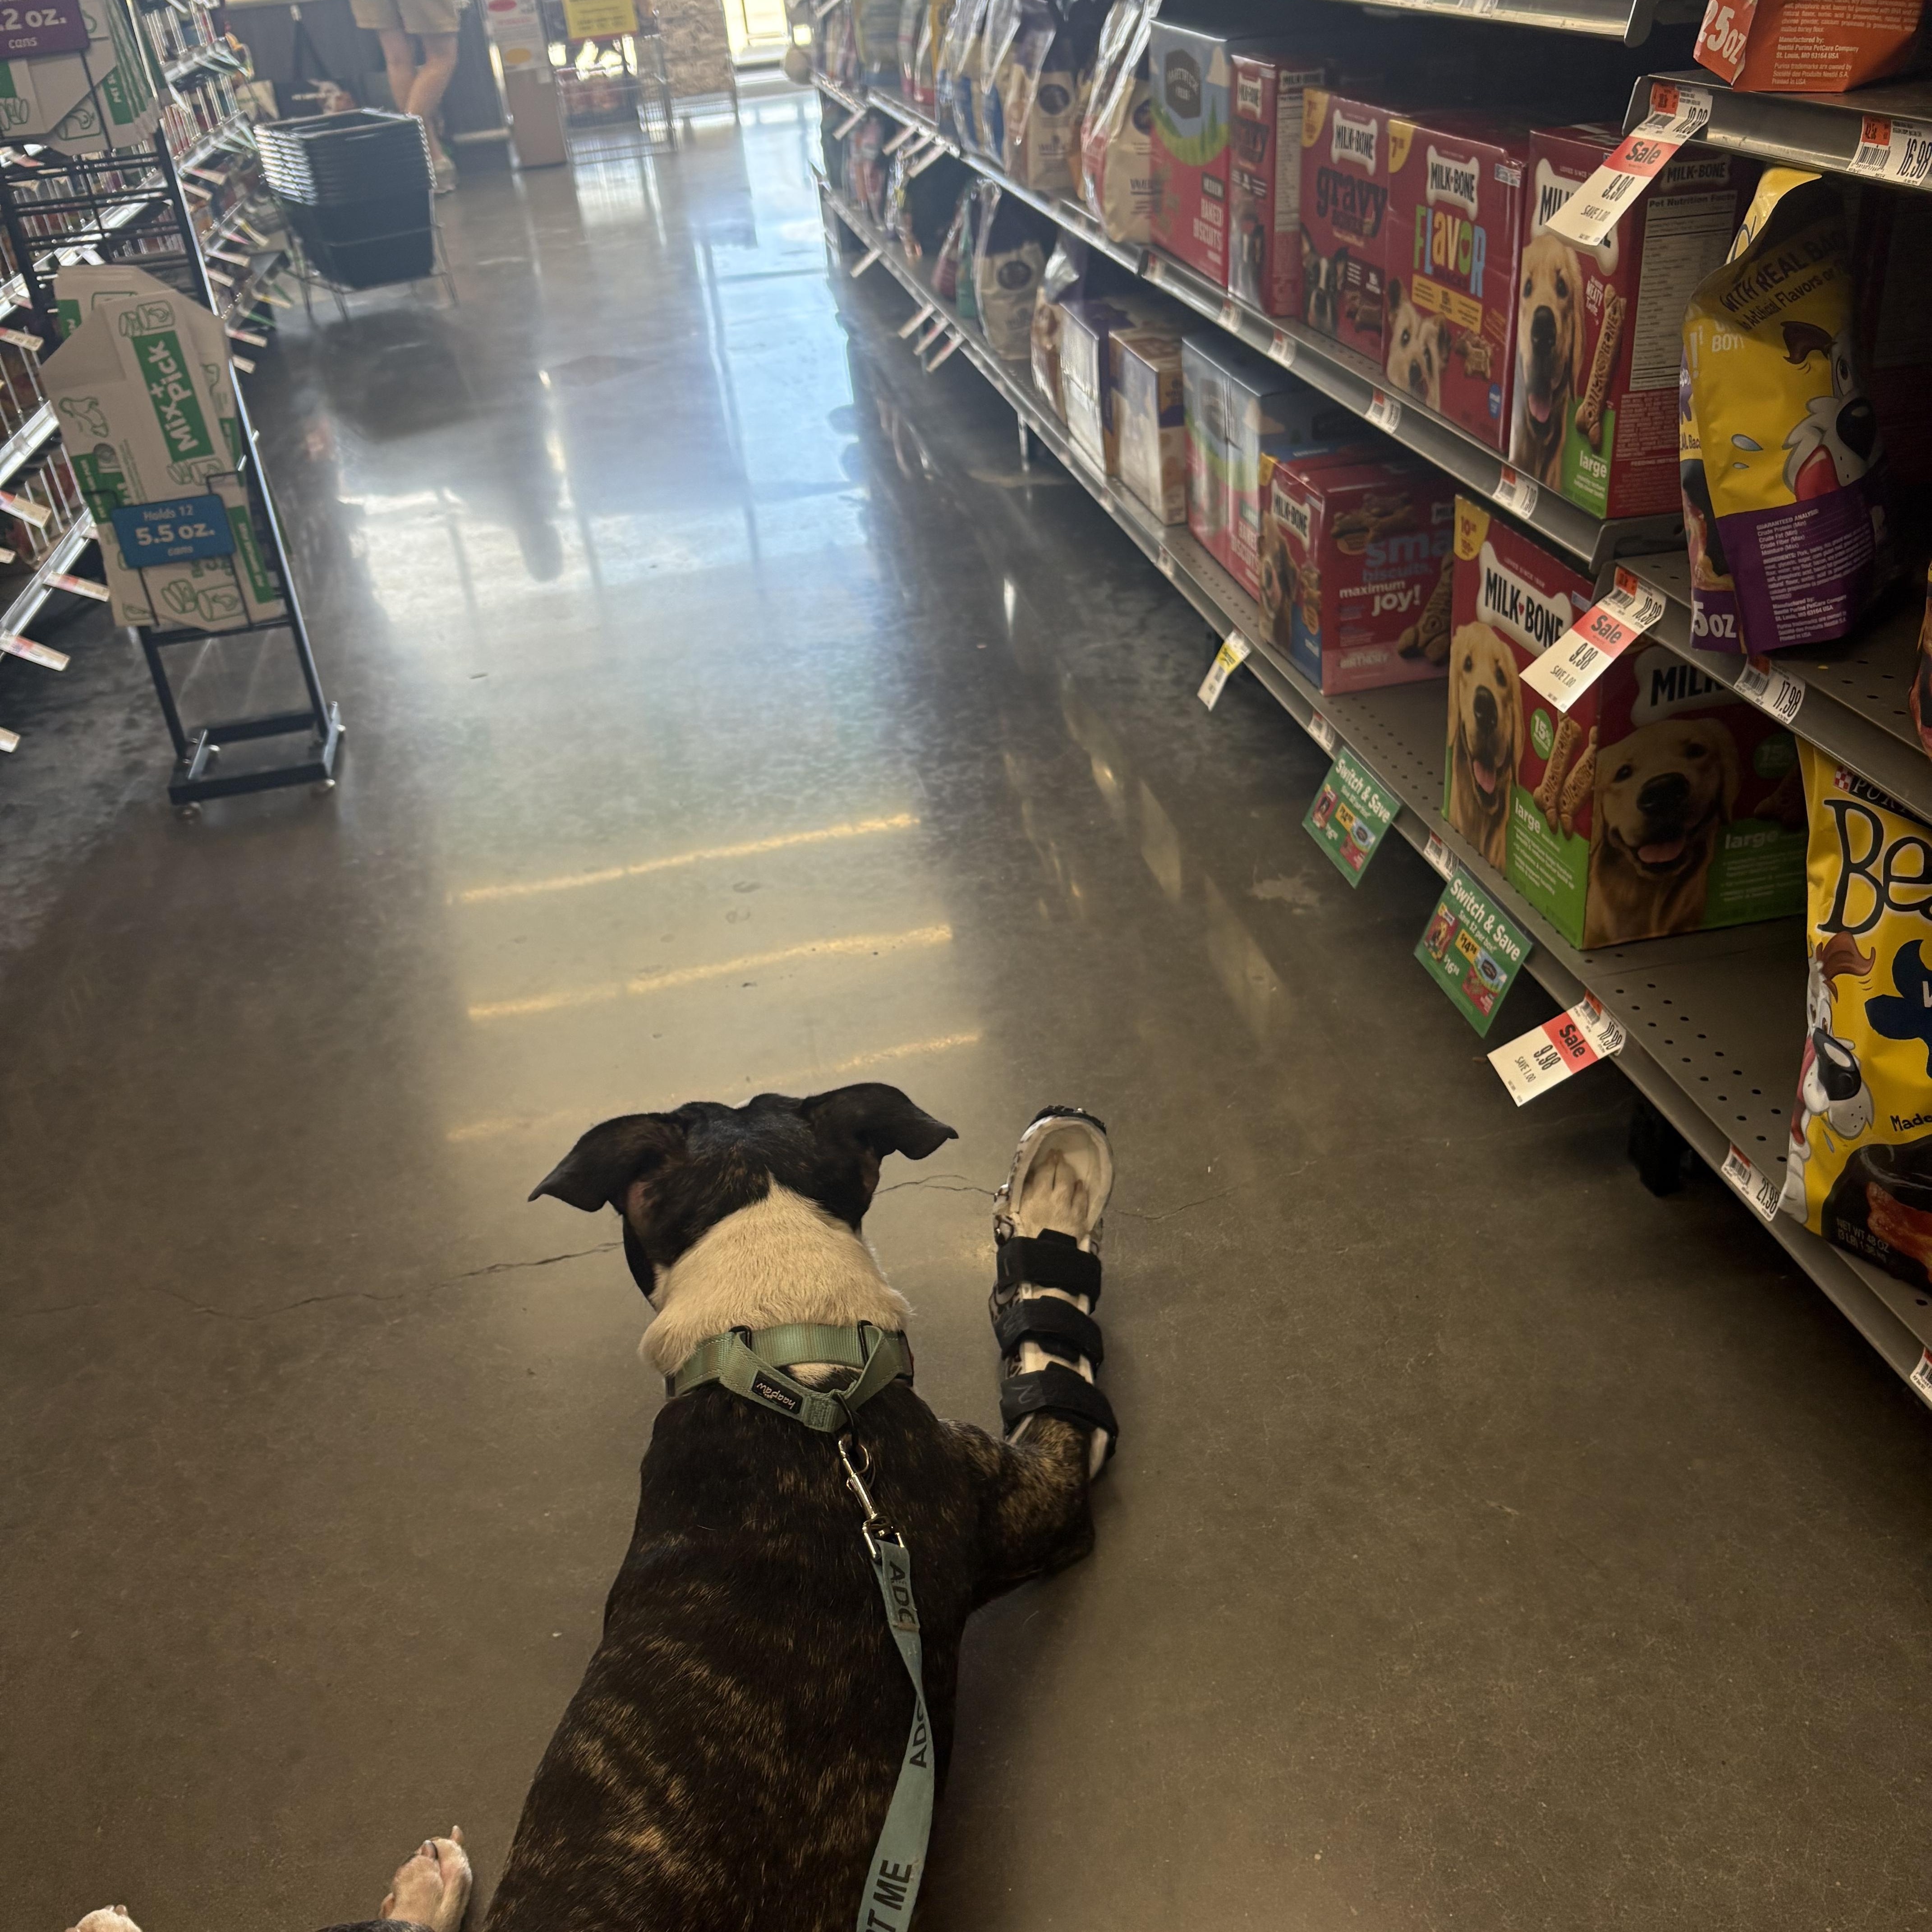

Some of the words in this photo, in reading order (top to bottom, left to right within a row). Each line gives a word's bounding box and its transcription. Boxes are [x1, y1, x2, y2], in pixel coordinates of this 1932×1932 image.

[25, 9, 67, 28] oz.
[9, 37, 37, 48] cans
[1625, 141, 1661, 165] Sale
[1896, 138, 1932, 179] 16.98
[1316, 166, 1388, 237] gravy
[1601, 174, 1635, 202] 9.98
[1720, 277, 1759, 313] WITH
[1755, 252, 1809, 293] REAL
[1775, 276, 1823, 308] Flavors
[158, 400, 199, 452] Mix
[1579, 450, 1607, 478] large
[143, 510, 176, 521] Holds
[179, 505, 194, 516] 12
[135, 524, 175, 546] 5.5
[178, 523, 216, 539] oz.
[167, 546, 194, 556] cans
[1339, 580, 1406, 598] maximum
[1371, 584, 1421, 616] joy!
[1591, 615, 1622, 644] Sale
[1569, 642, 1597, 671] 9.98
[1550, 664, 1566, 682] SAVE
[1773, 680, 1801, 718] 17.98
[1335, 759, 1364, 795] Switch
[1368, 794, 1390, 823] Save
[1515, 797, 1541, 834] large
[1817, 799, 1932, 934] Be
[1450, 878, 1485, 923] Switch
[1483, 914, 1495, 934] &
[1493, 924, 1520, 961] Save
[1559, 1023, 1586, 1058] Sale
[1514, 1056, 1530, 1072] SAVE
[1533, 1044, 1561, 1070] 9.98
[1891, 1111, 1932, 1132] Made
[1756, 1178, 1780, 1214] 21.98
[756, 1381, 796, 1410] haapaw
[873, 1860, 912, 1911] ME
